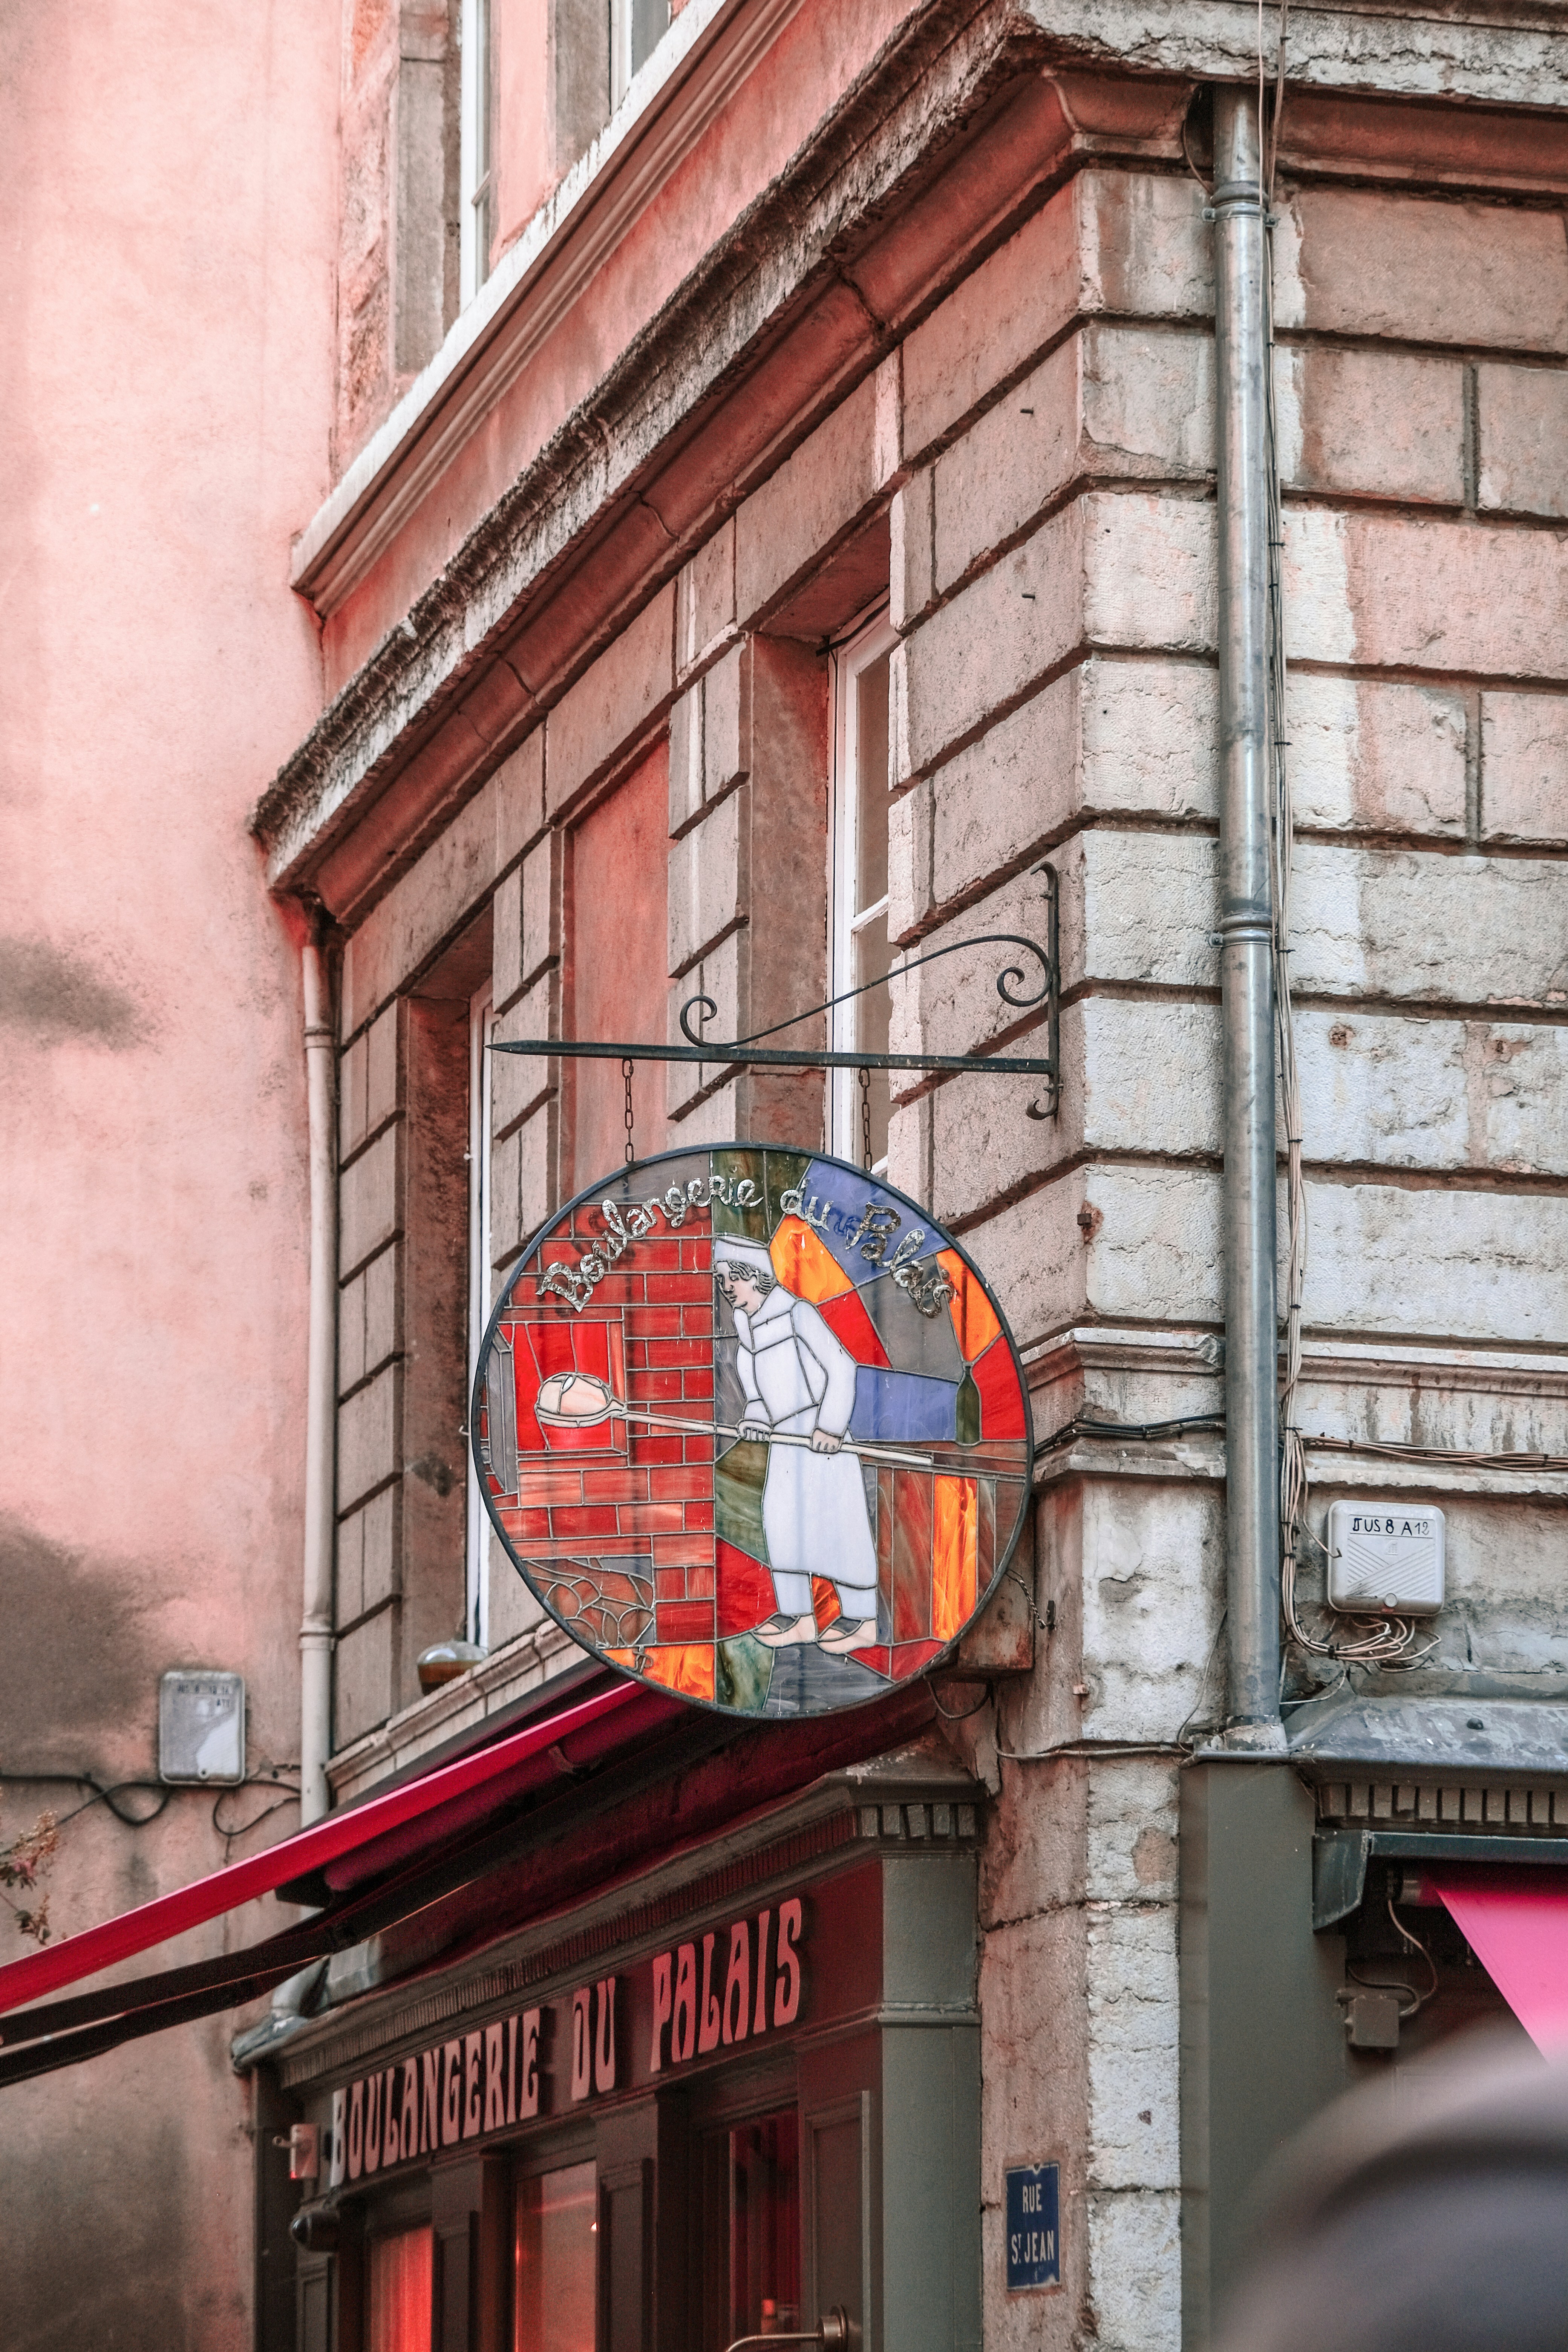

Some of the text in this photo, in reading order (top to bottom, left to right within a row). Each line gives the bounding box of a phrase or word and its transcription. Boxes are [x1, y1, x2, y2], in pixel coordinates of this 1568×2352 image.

[780, 1178, 834, 1231] du
[845, 1201, 953, 1319] Palais
[330, 1898, 802, 2187] BOULANGERIE DU PALAIS
[1023, 2184, 1042, 2213] RUE
[1024, 2230, 1055, 2263] JEAN
